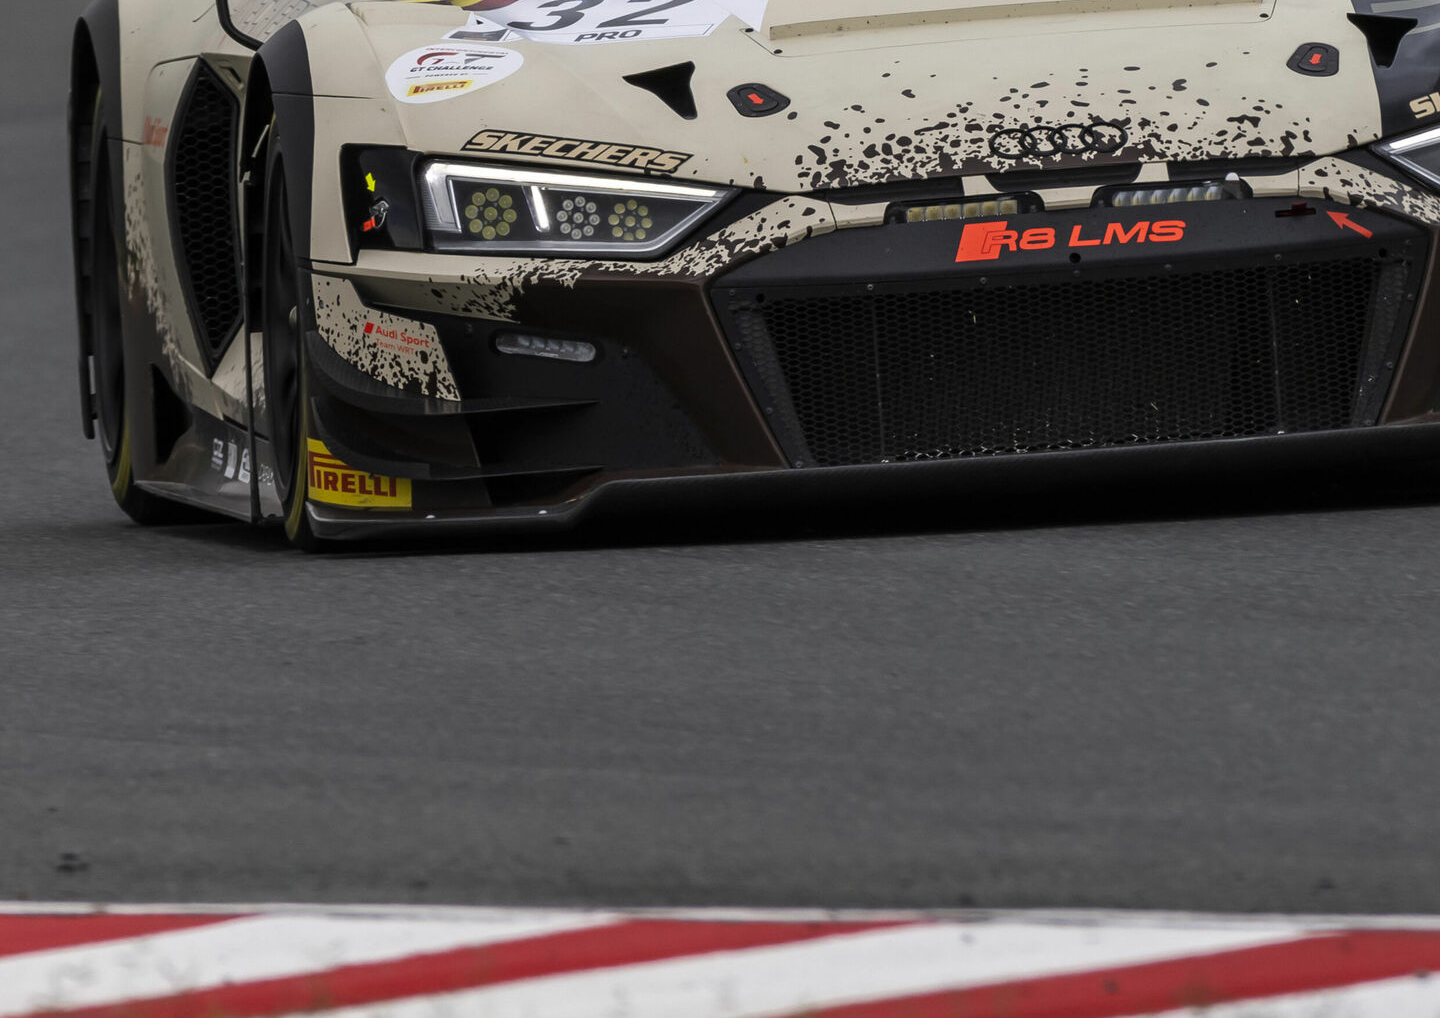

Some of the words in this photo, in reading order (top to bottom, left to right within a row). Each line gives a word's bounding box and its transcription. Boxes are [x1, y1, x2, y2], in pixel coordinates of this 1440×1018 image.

[574, 29, 642, 43] PRO
[463, 131, 692, 172] SKECHERS
[980, 226, 1056, 254] R8
[1068, 220, 1187, 248] LMS
[375, 325, 398, 340] Audi
[400, 332, 430, 348] Sport
[375, 338, 396, 350] Team
